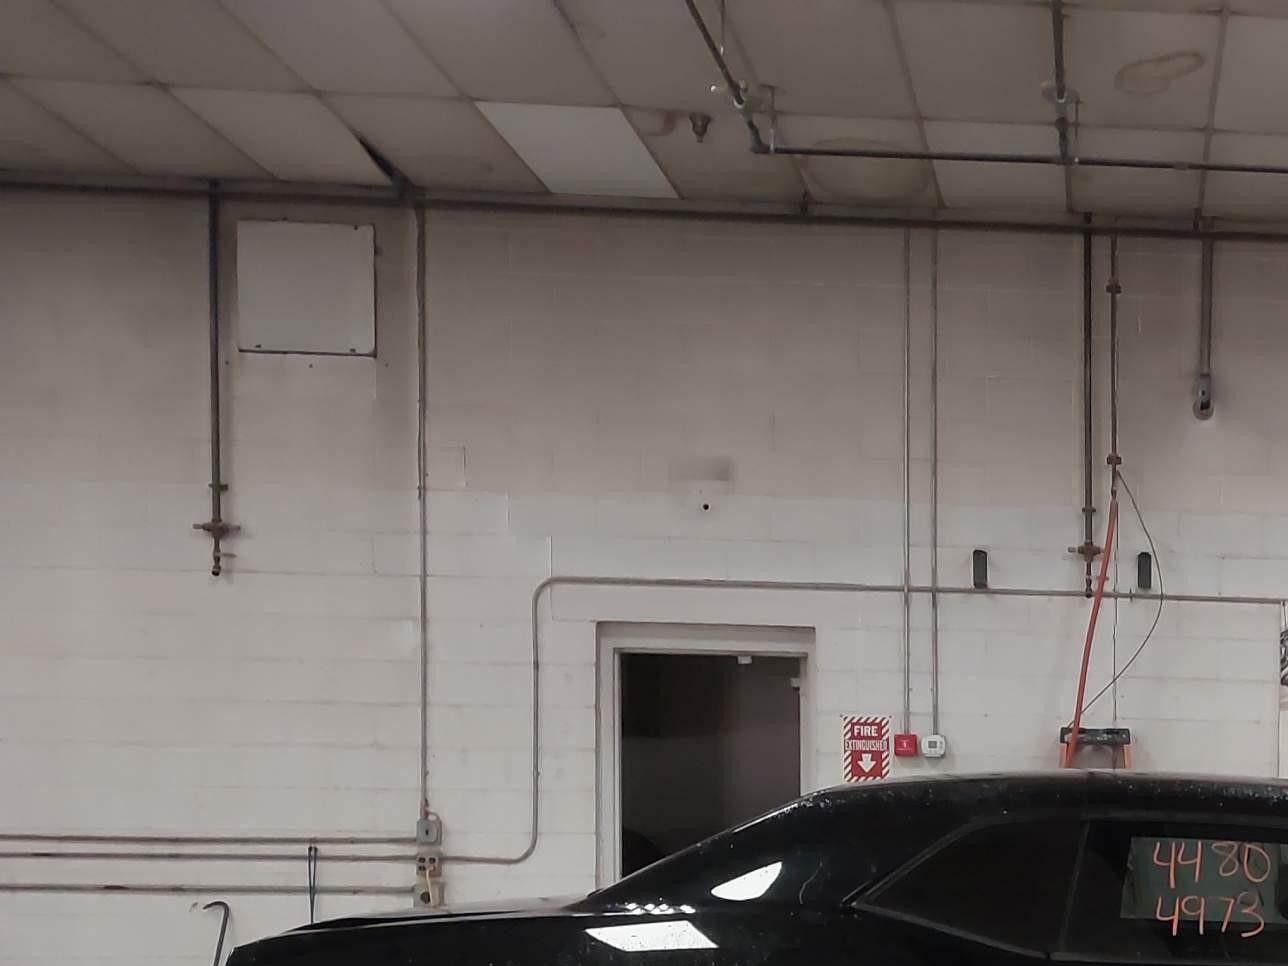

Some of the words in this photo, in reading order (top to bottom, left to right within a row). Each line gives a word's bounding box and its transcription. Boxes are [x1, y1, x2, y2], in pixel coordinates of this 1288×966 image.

[845, 740, 888, 751] EXTINGUISHER
[854, 726, 878, 736] FIRE
[1153, 841, 1271, 889] 4480
[1156, 891, 1264, 938] 4973
